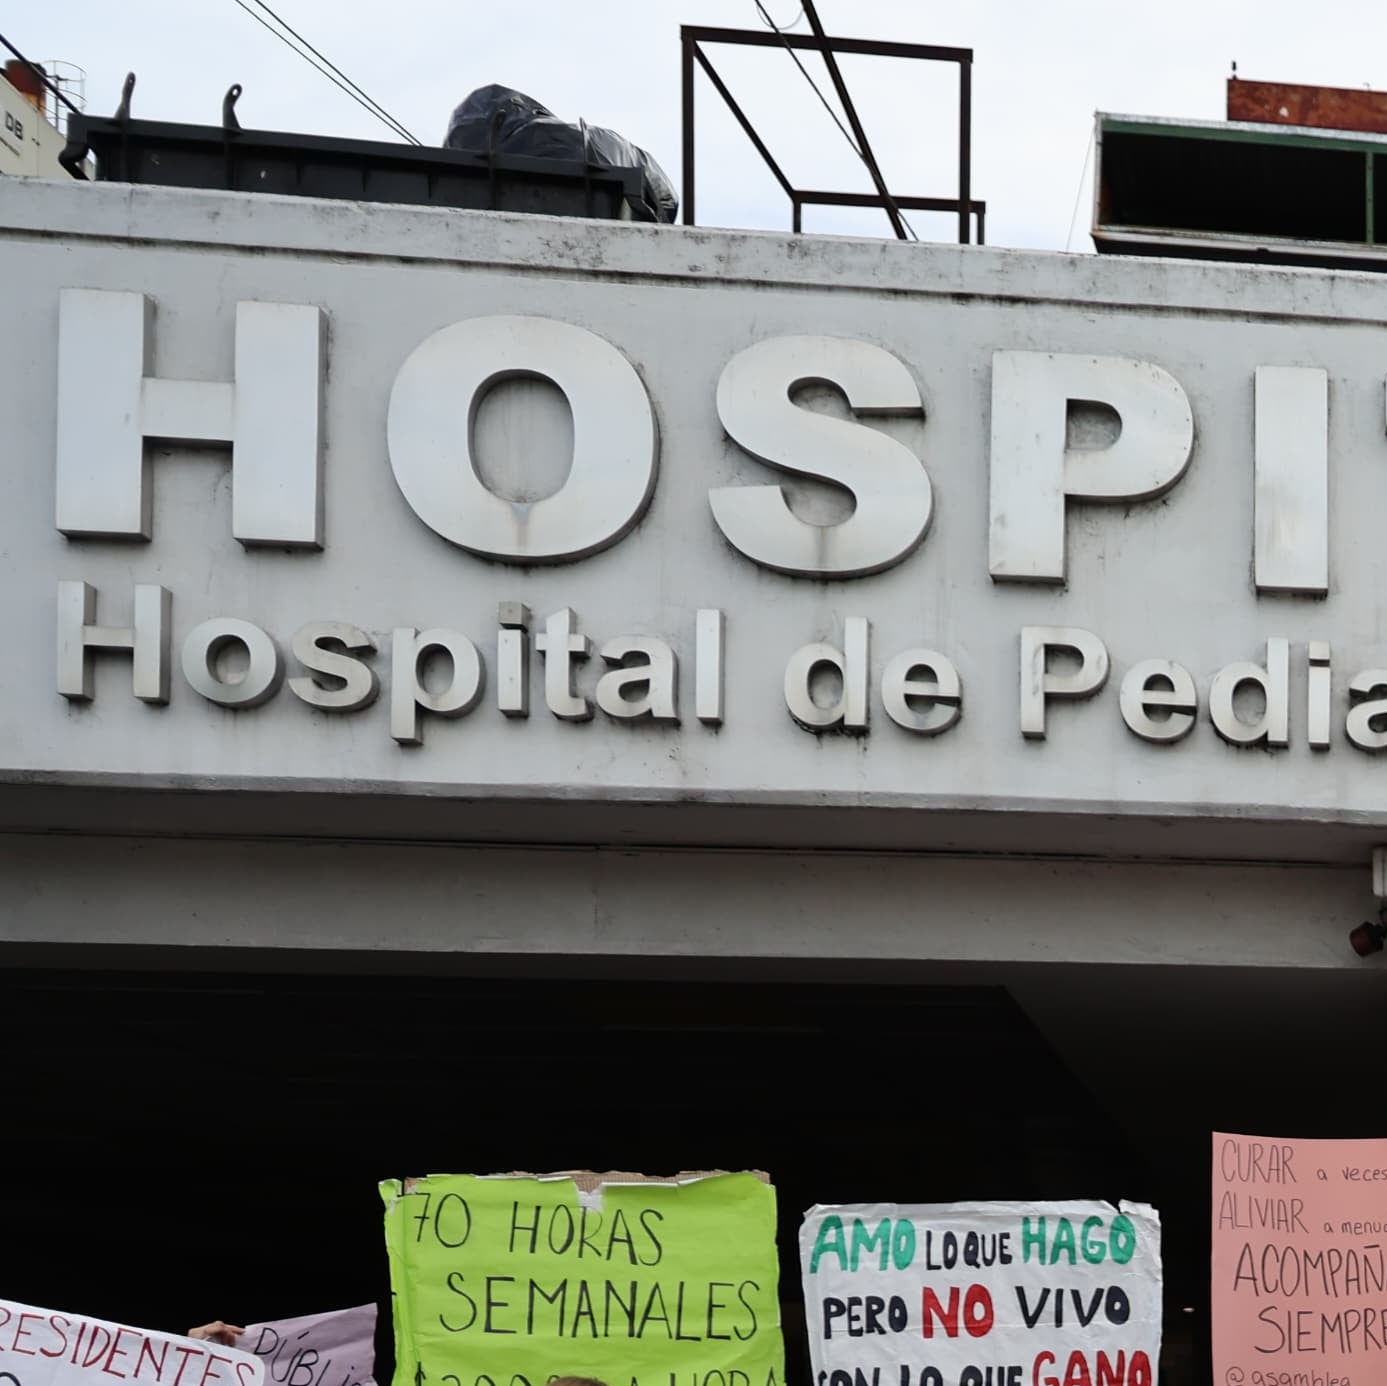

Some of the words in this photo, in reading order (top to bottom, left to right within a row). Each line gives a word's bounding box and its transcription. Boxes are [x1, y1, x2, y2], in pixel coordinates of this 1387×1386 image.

[56, 578, 726, 748] Hospital
[782, 616, 962, 737] de
[1219, 1138, 1297, 1185] CURAR
[1316, 1168, 1328, 1181] a
[414, 1192, 471, 1248] 70
[509, 1200, 665, 1267] HORAS
[809, 1213, 917, 1275] AMO
[925, 1232, 959, 1271] LO
[963, 1229, 1013, 1270] QUE
[1021, 1212, 1138, 1267] HAGO
[1218, 1190, 1310, 1235] ALIVIAR
[1323, 1222, 1334, 1234] a
[439, 1271, 761, 1342] SEMANALES
[822, 1294, 909, 1341] PERO
[921, 1282, 994, 1338] NO
[1015, 1285, 1131, 1329] VIVO
